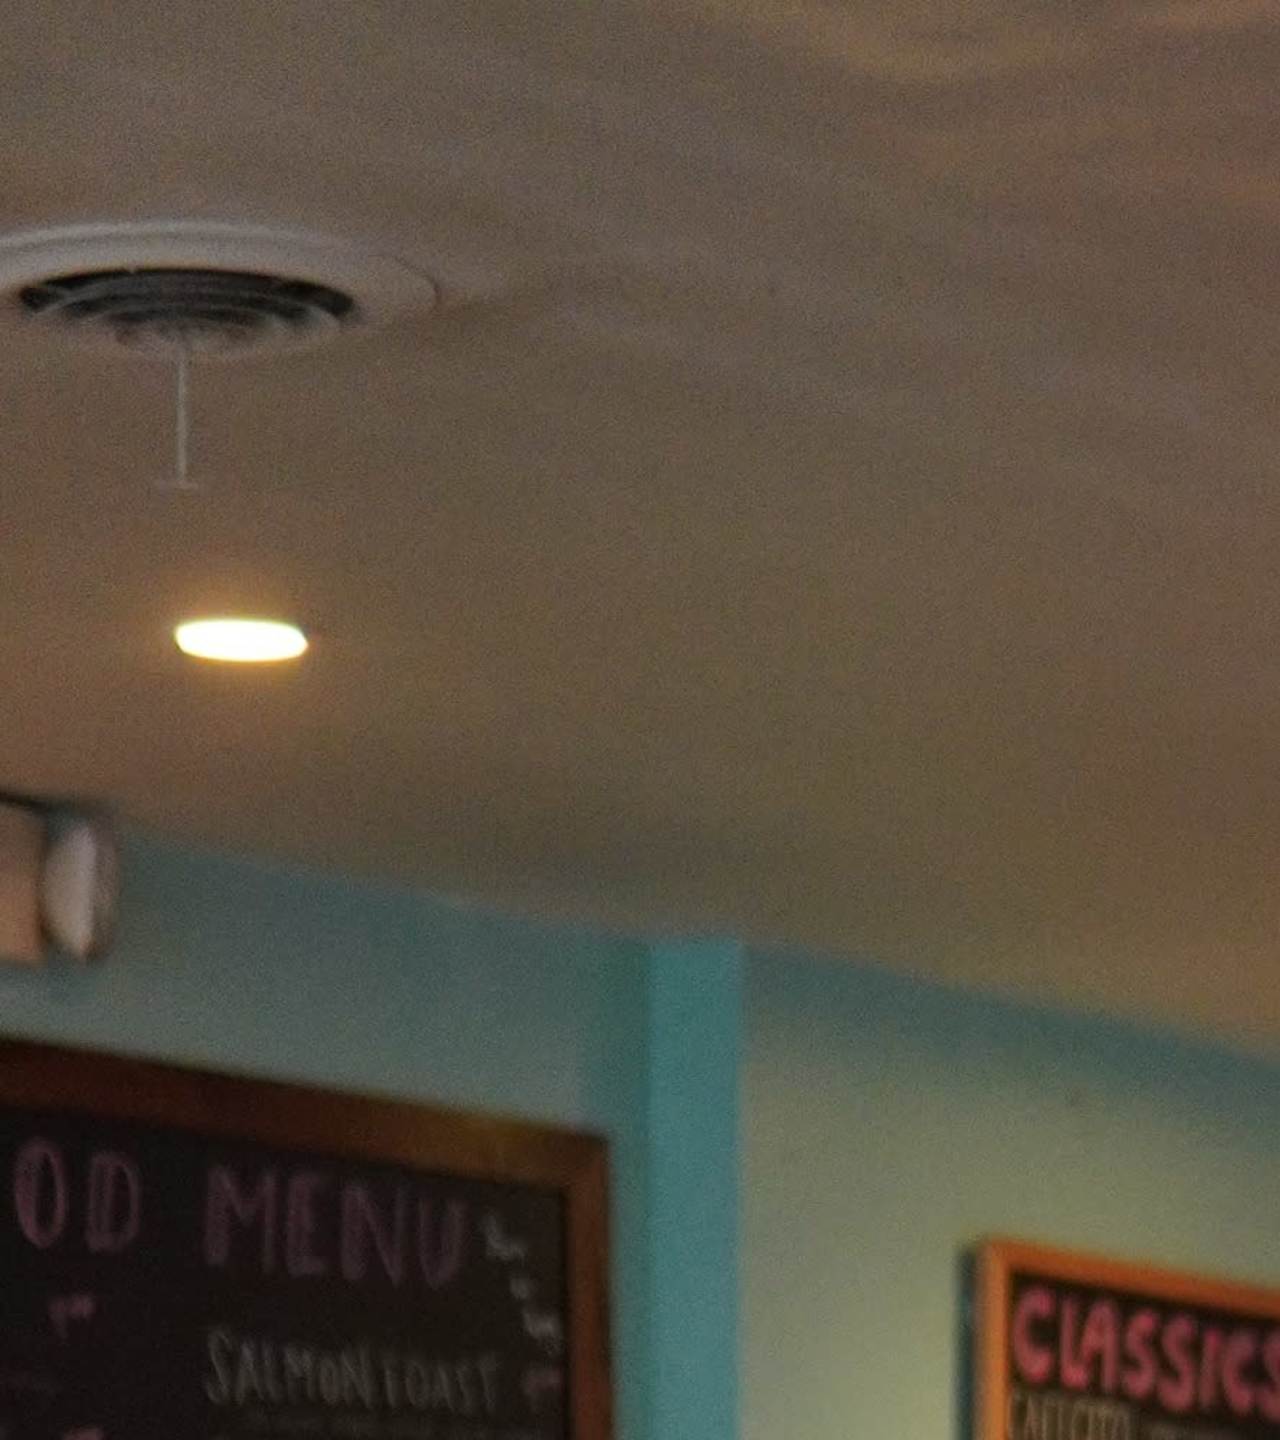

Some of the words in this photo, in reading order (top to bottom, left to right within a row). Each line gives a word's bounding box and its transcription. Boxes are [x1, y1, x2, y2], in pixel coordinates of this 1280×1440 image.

[205, 1163, 468, 1291] MENU
[204, 1328, 372, 1410] SALMON
[377, 1350, 498, 1414] TOAST
